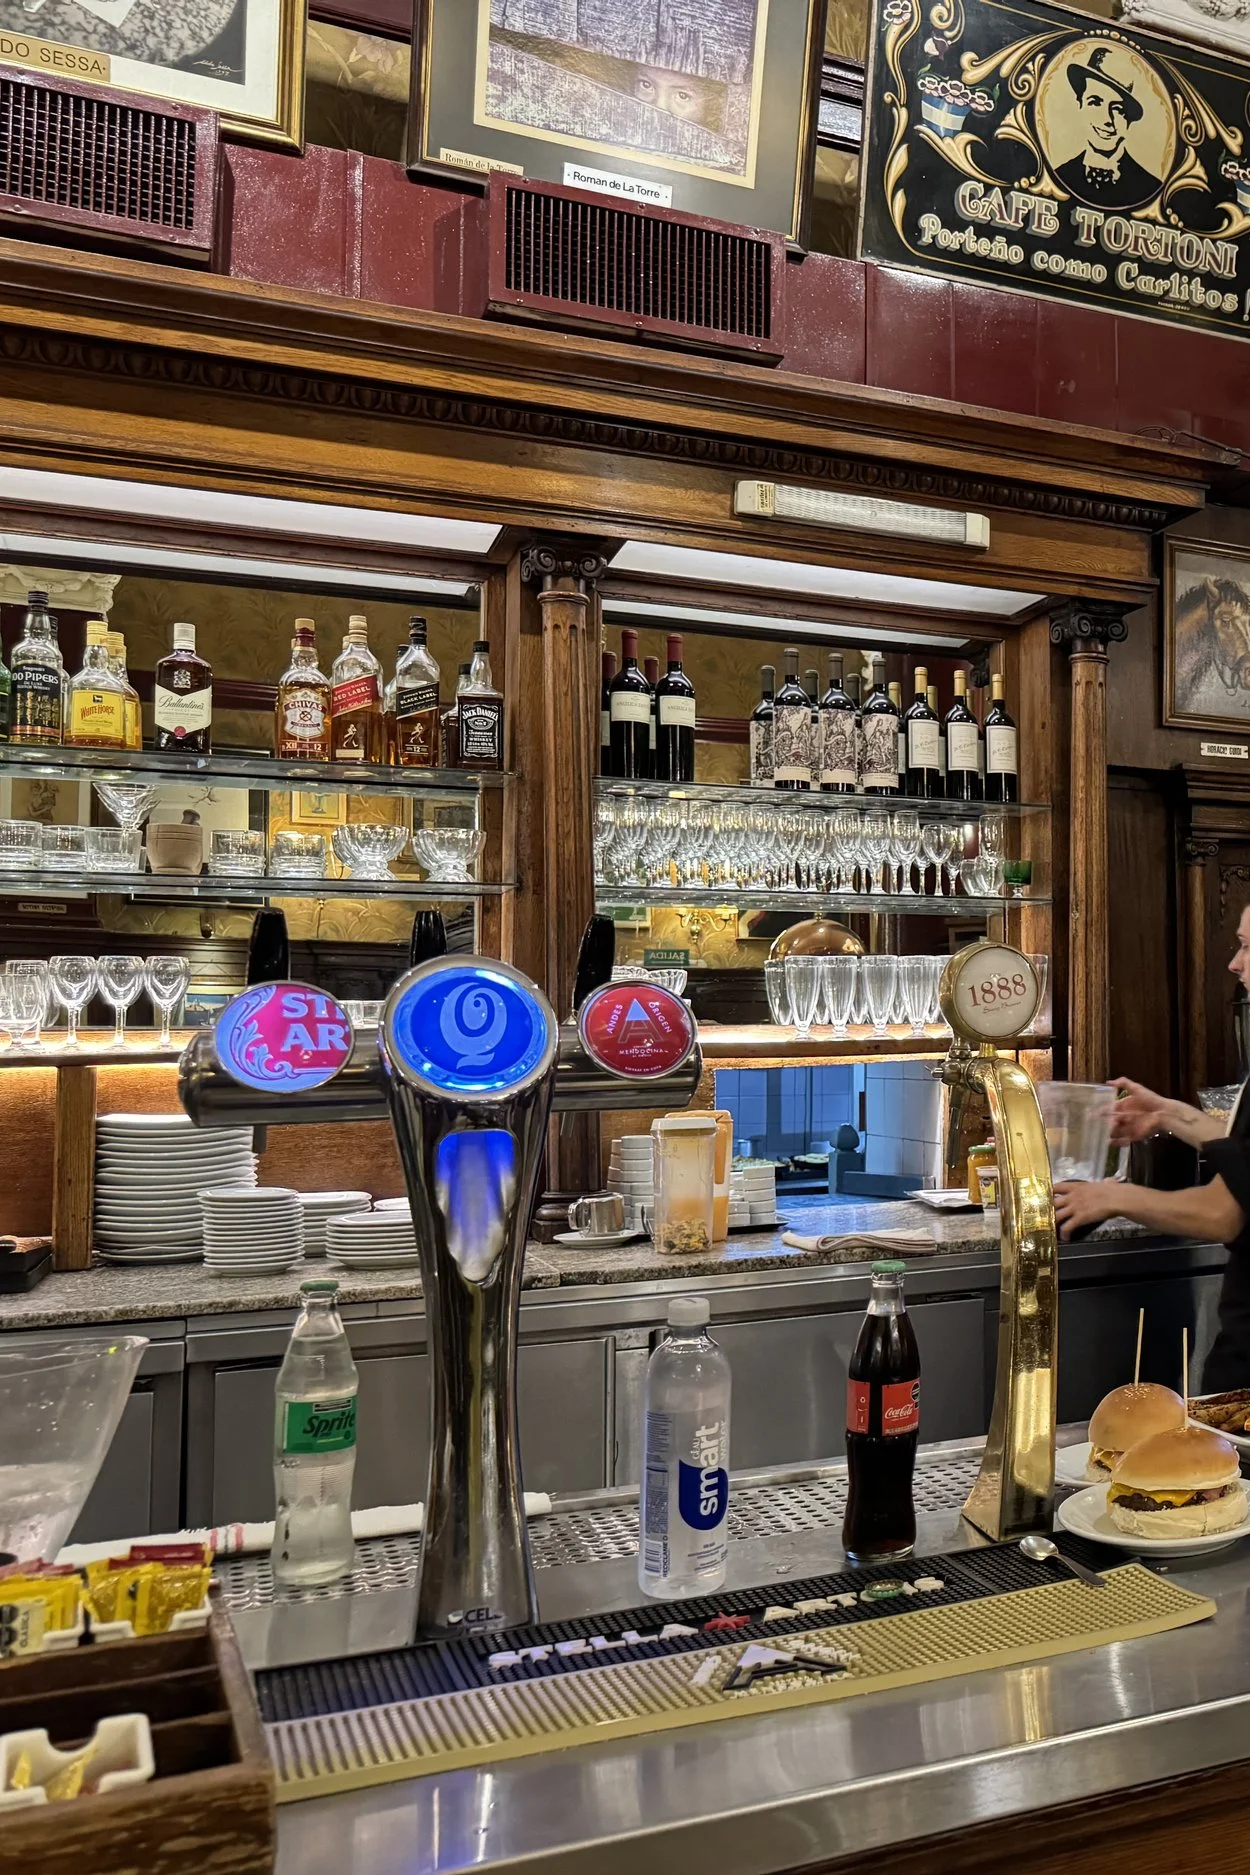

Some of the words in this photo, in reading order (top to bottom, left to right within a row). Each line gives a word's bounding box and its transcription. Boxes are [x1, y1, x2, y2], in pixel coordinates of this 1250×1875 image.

[40, 47, 103, 75] SESSA
[475, 159, 486, 170] de
[573, 171, 608, 187] Roman
[609, 178, 622, 190] de
[623, 182, 635, 193] La
[634, 185, 661, 199] Torre
[955, 180, 1060, 235] CAFE
[1074, 205, 1239, 278] TORTONI
[917, 213, 1025, 265] Porteño
[1032, 249, 1108, 283] como
[1114, 261, 1239, 313] Carlitos
[25, 671, 59, 685] PIPERS
[289, 700, 323, 711] CHIVAS
[333, 693, 347, 702] RED
[347, 685, 371, 697] LABEL
[400, 696, 419, 705] BLACK
[418, 692, 438, 700] LABEL
[80, 705, 97, 721] WHITE
[462, 708, 477, 720] JACK
[313, 743, 322, 751] 12
[967, 973, 1027, 1008] 1888
[605, 1003, 624, 1034] ANDES
[648, 1001, 673, 1034] ORIGEN
[698, 1421, 720, 1517] smart
[488, 1622, 699, 1670] STELLA
